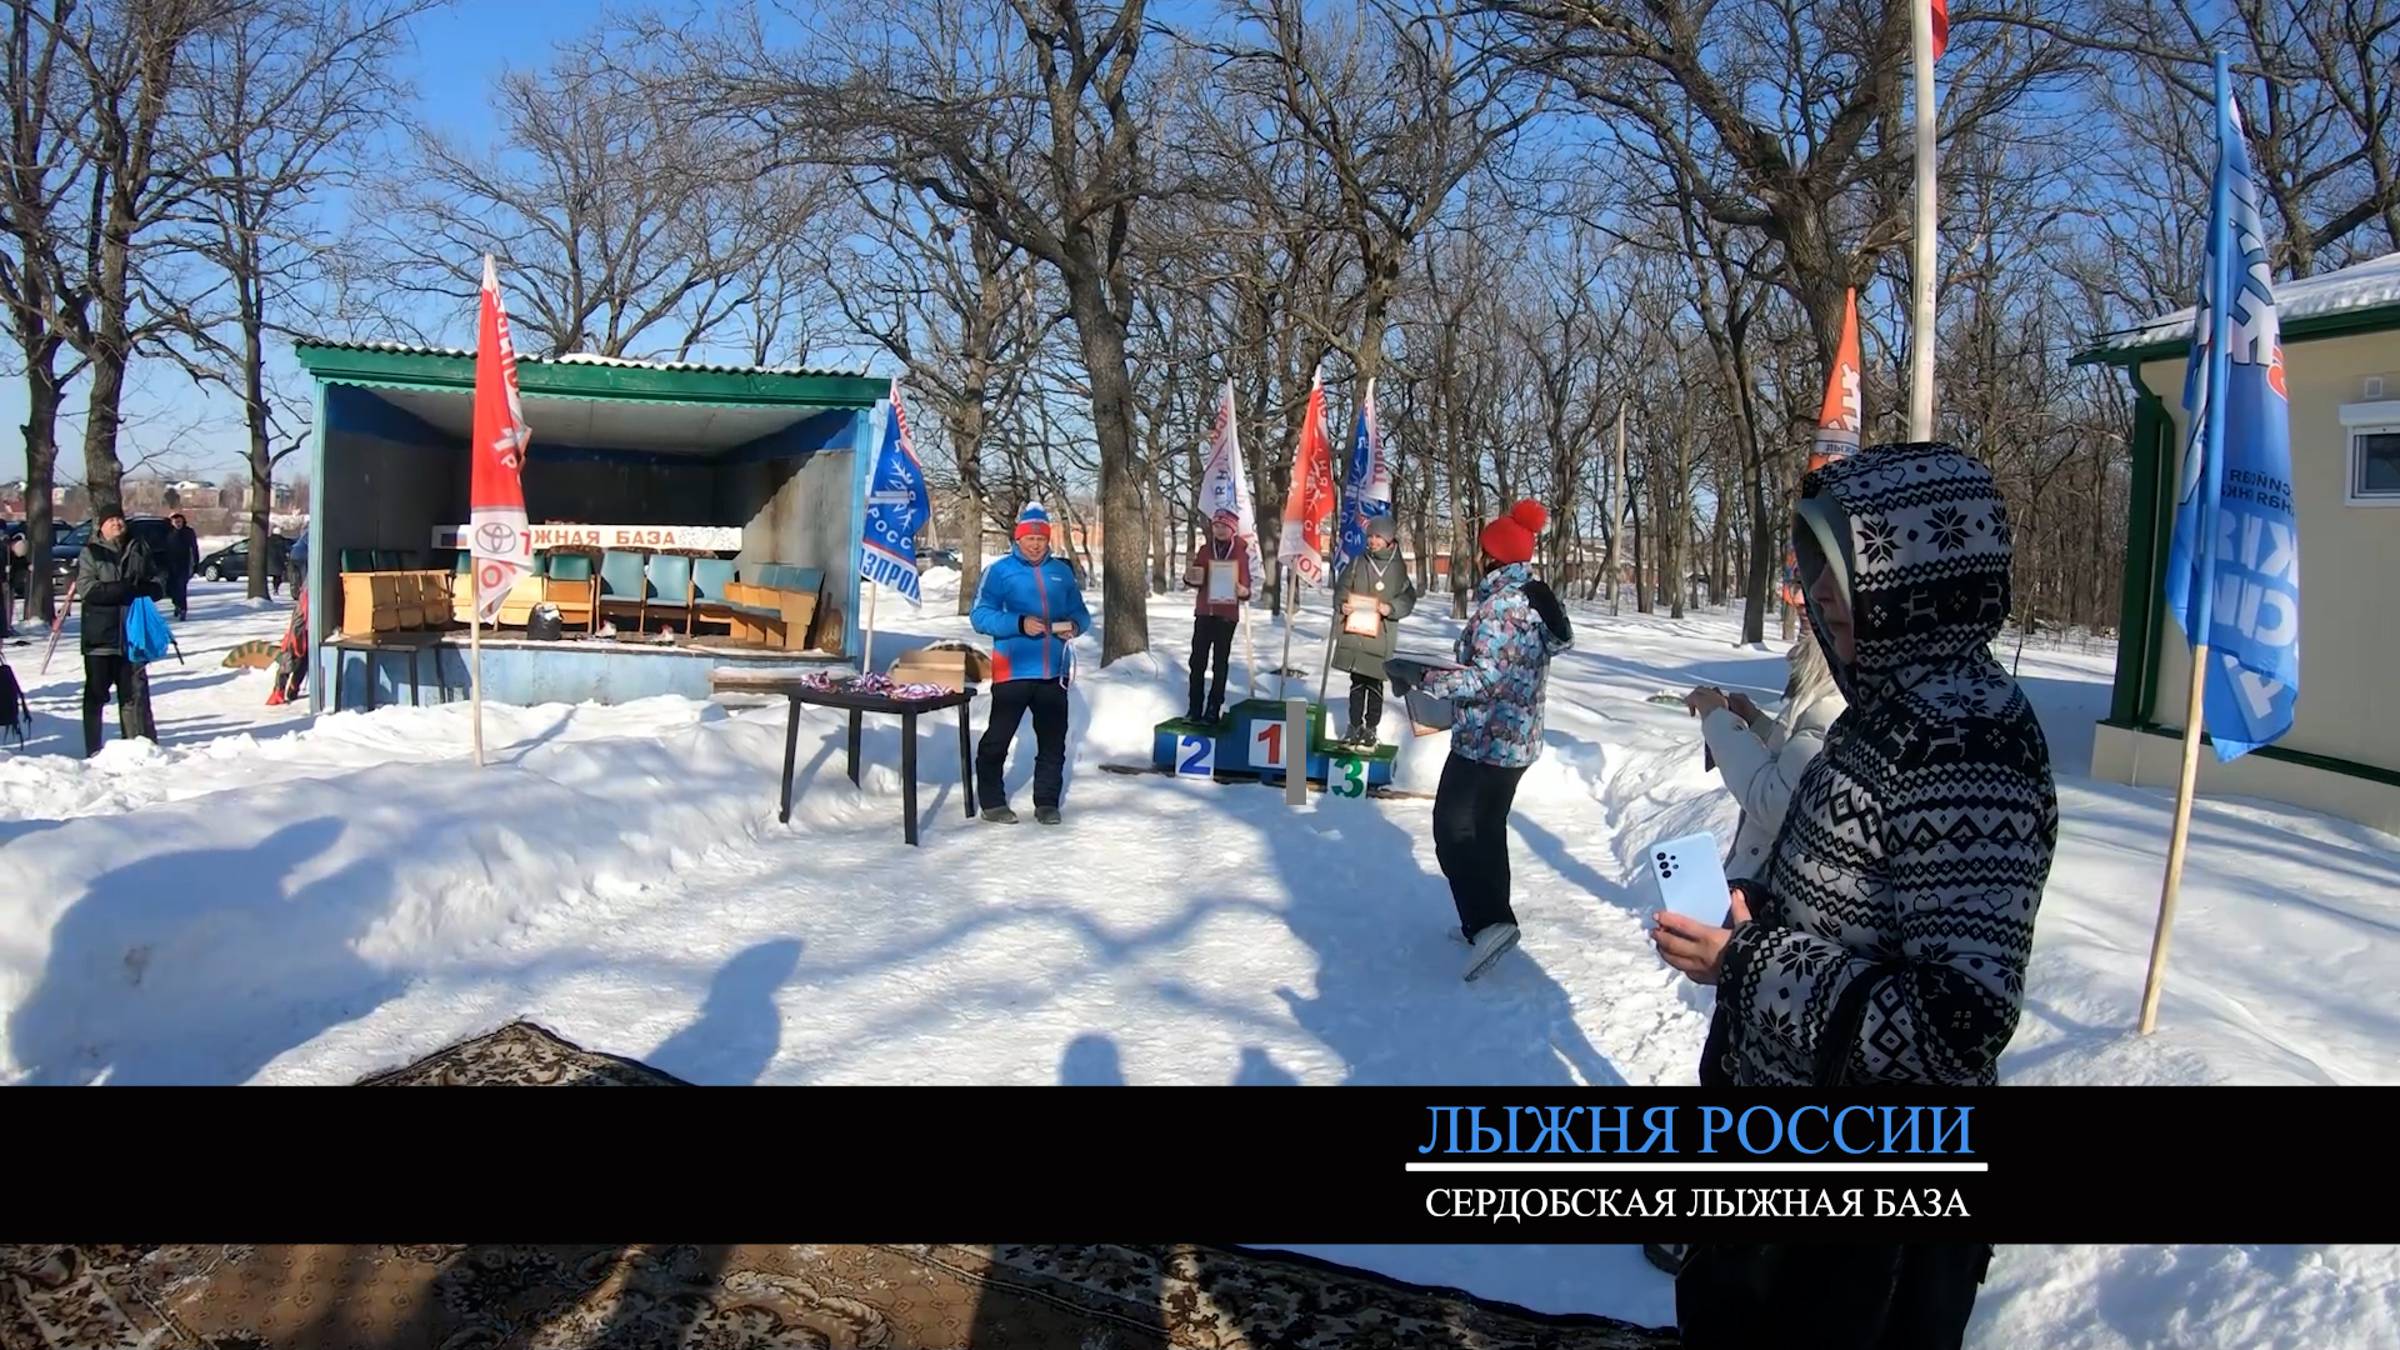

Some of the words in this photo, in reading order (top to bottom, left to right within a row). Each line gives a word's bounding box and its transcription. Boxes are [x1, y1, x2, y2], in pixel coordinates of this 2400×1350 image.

[533, 529, 600, 546] ЖНАЯ
[616, 531, 676, 545] БАЗА
[867, 506, 912, 550] РОСС
[1179, 736, 1211, 775] 2
[1258, 724, 1281, 764] 1
[1331, 758, 1364, 798] 3
